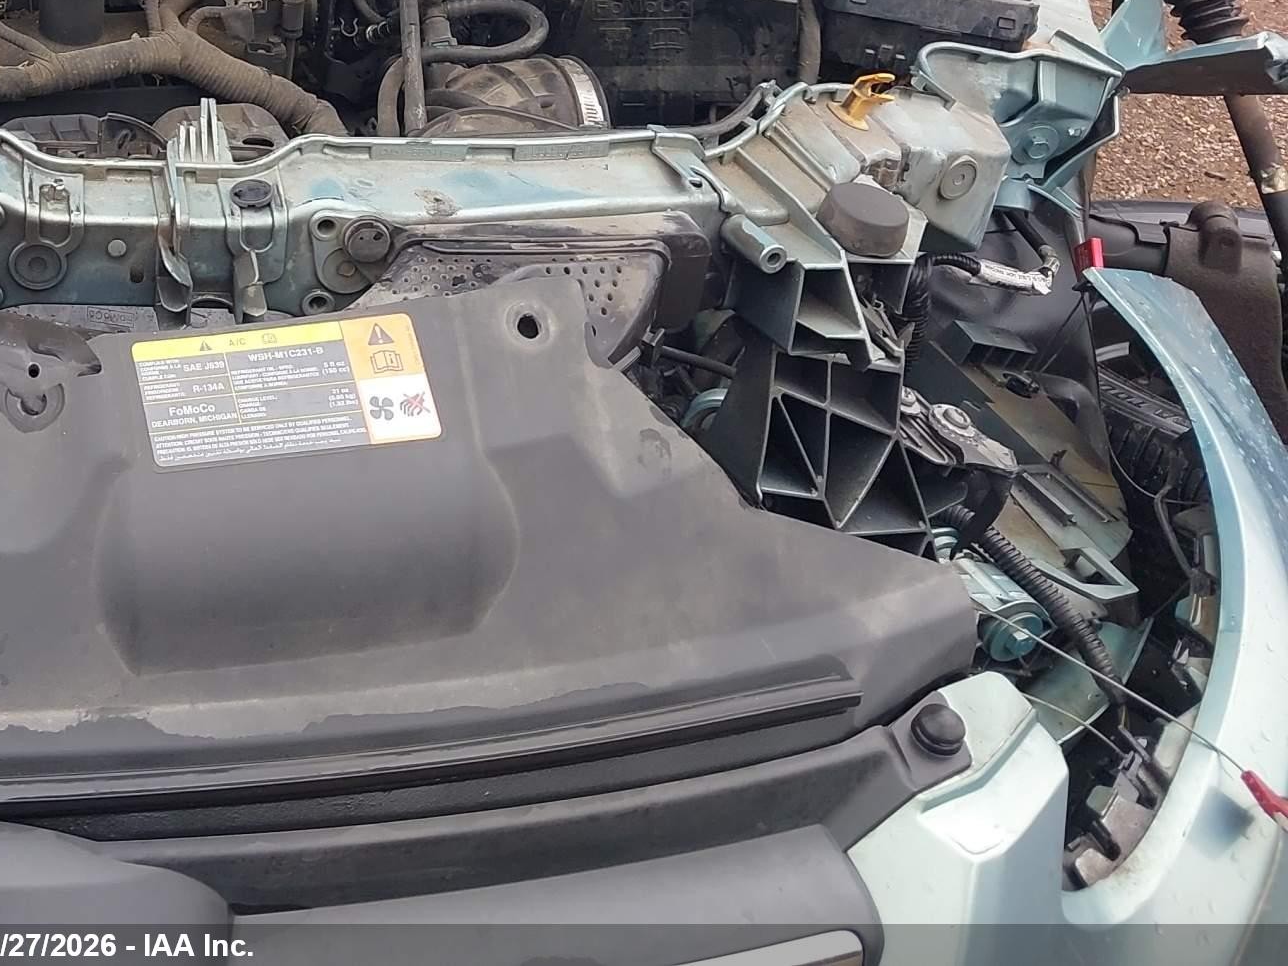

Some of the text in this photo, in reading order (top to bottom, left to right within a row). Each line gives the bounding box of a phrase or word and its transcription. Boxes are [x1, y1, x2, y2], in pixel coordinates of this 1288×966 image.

[248, 347, 323, 362] WSH-M1C231-B
[192, 383, 224, 392] R-134A
[169, 404, 214, 416] FoMoCo
[152, 413, 236, 428] DEARBORN, MICHIGAN
